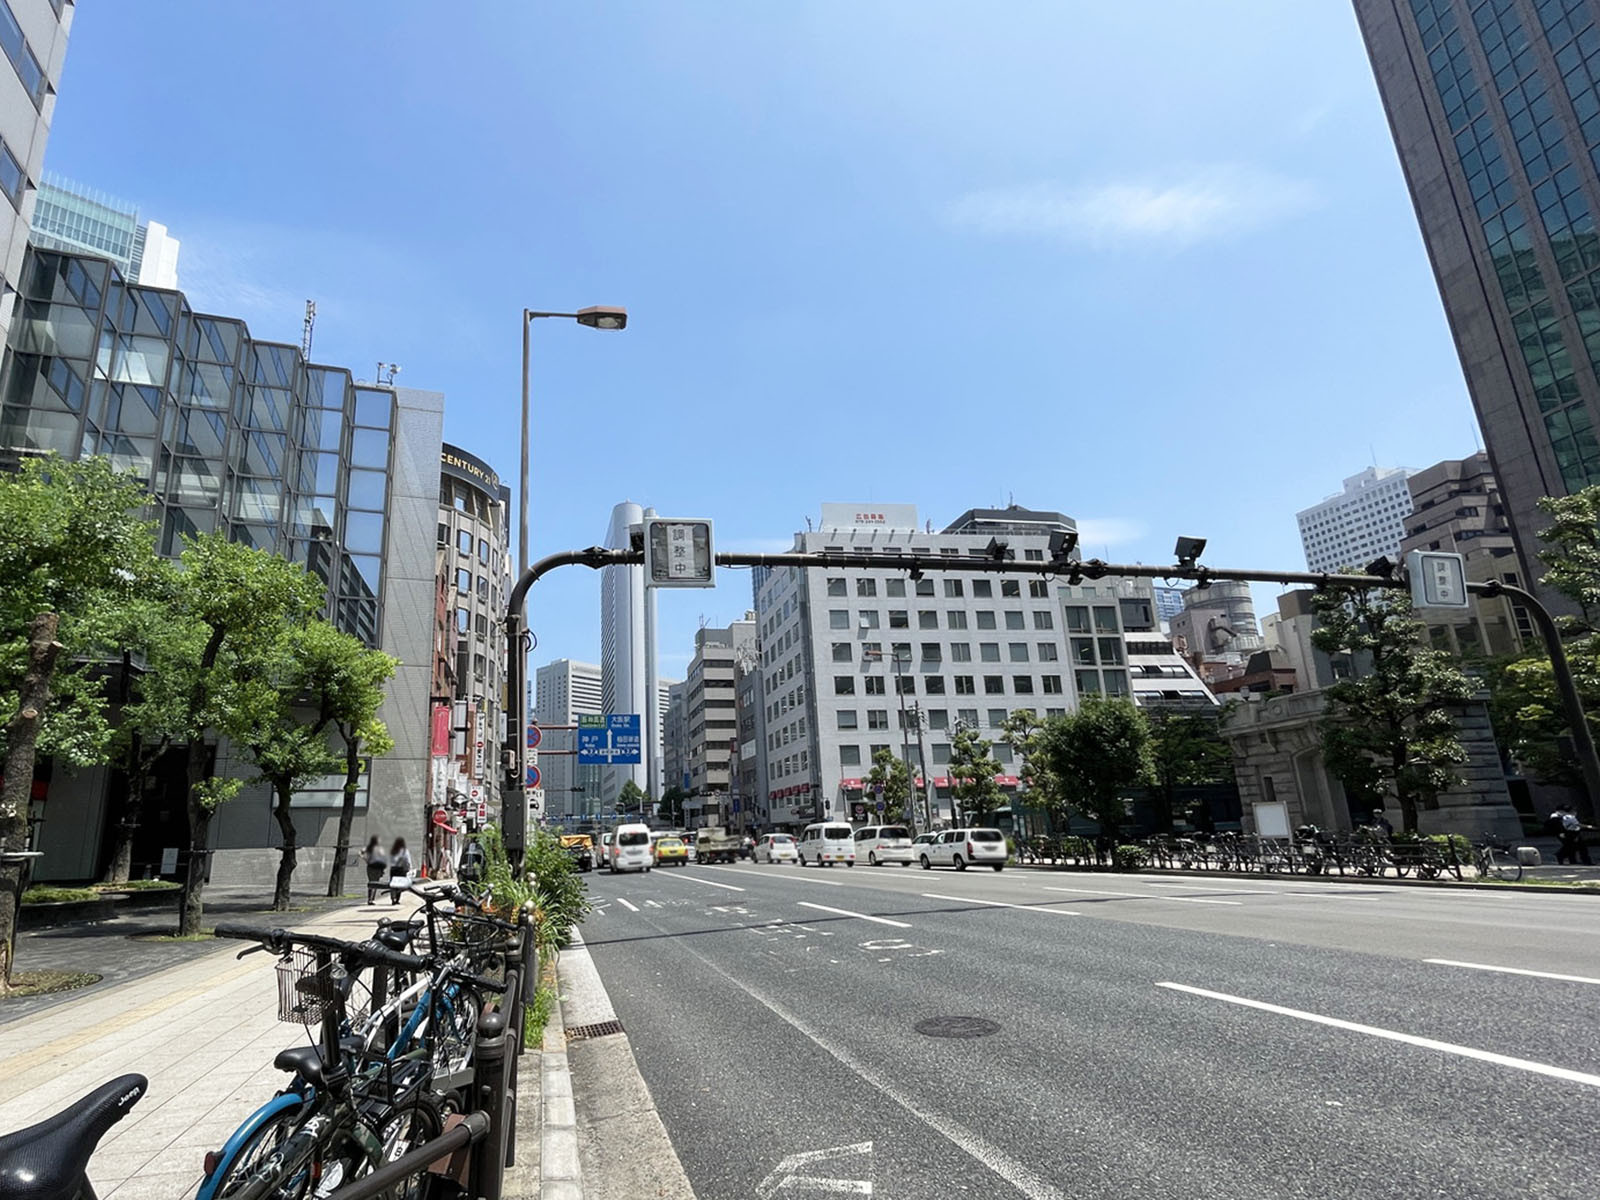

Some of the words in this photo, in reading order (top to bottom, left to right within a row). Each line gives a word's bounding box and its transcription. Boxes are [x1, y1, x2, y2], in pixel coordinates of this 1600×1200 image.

[440, 453, 485, 478] CENTURY
[485, 474, 491, 485] 21
[672, 528, 686, 574] 調整中
